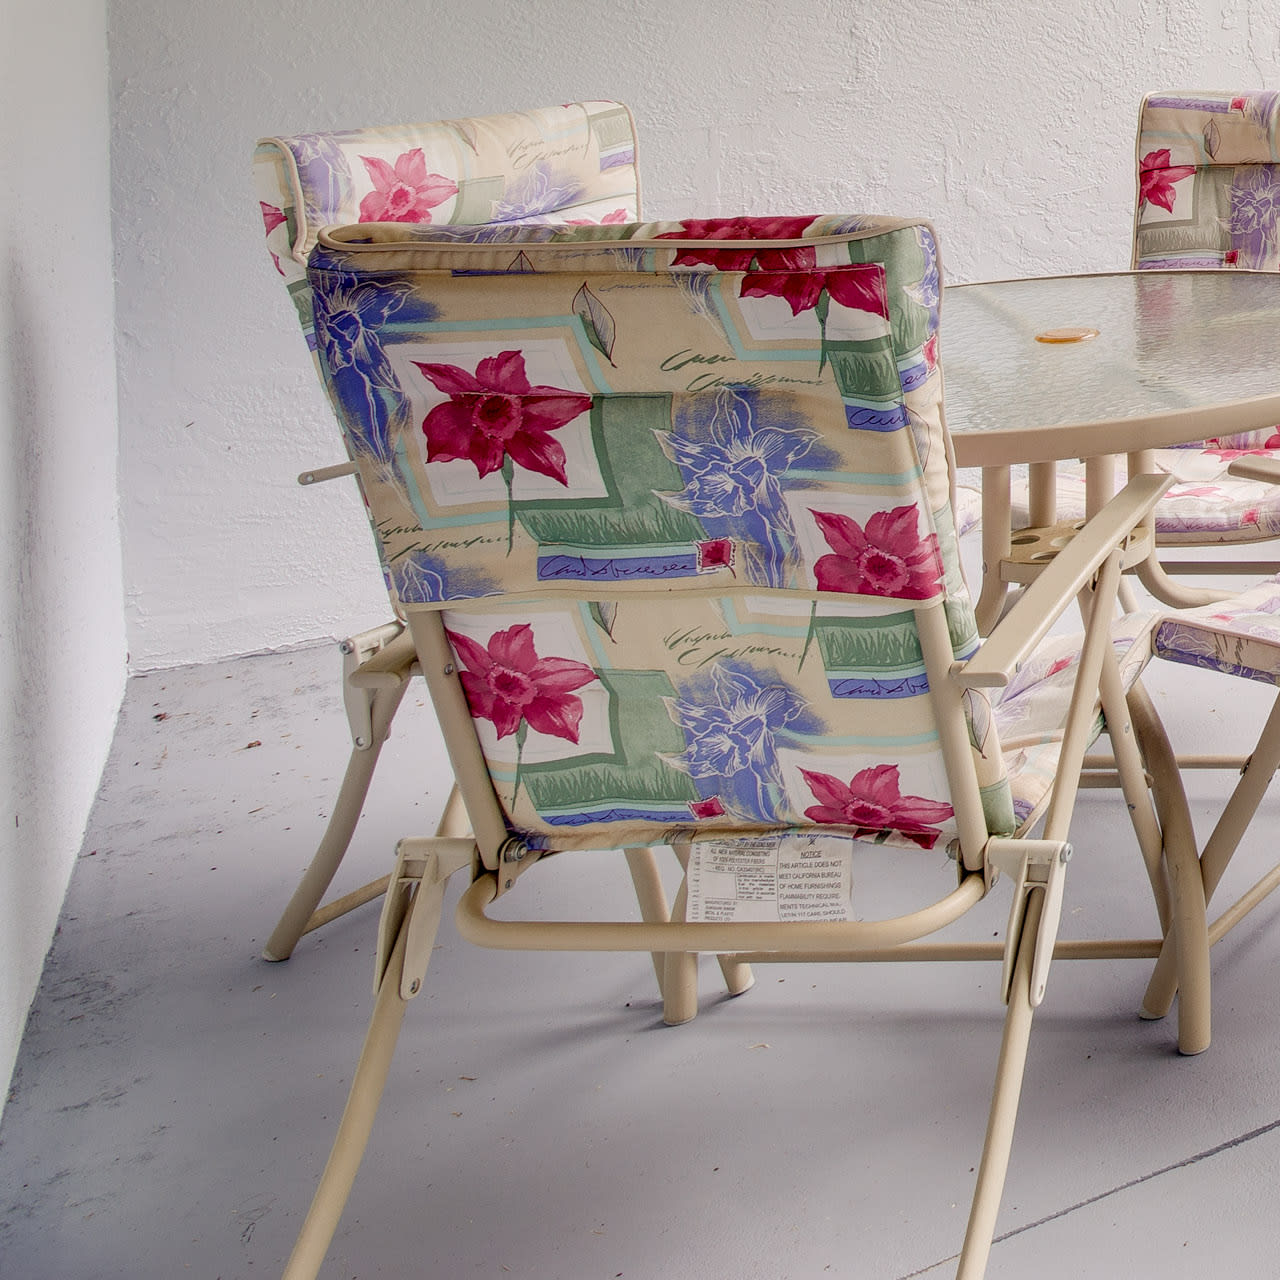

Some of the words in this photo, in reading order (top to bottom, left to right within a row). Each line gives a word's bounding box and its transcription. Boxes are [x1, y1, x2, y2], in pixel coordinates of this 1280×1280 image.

[800, 850, 822, 858] NOTICE
[821, 871, 842, 879] BUREAU
[804, 882, 841, 890] FURNISHINGS
